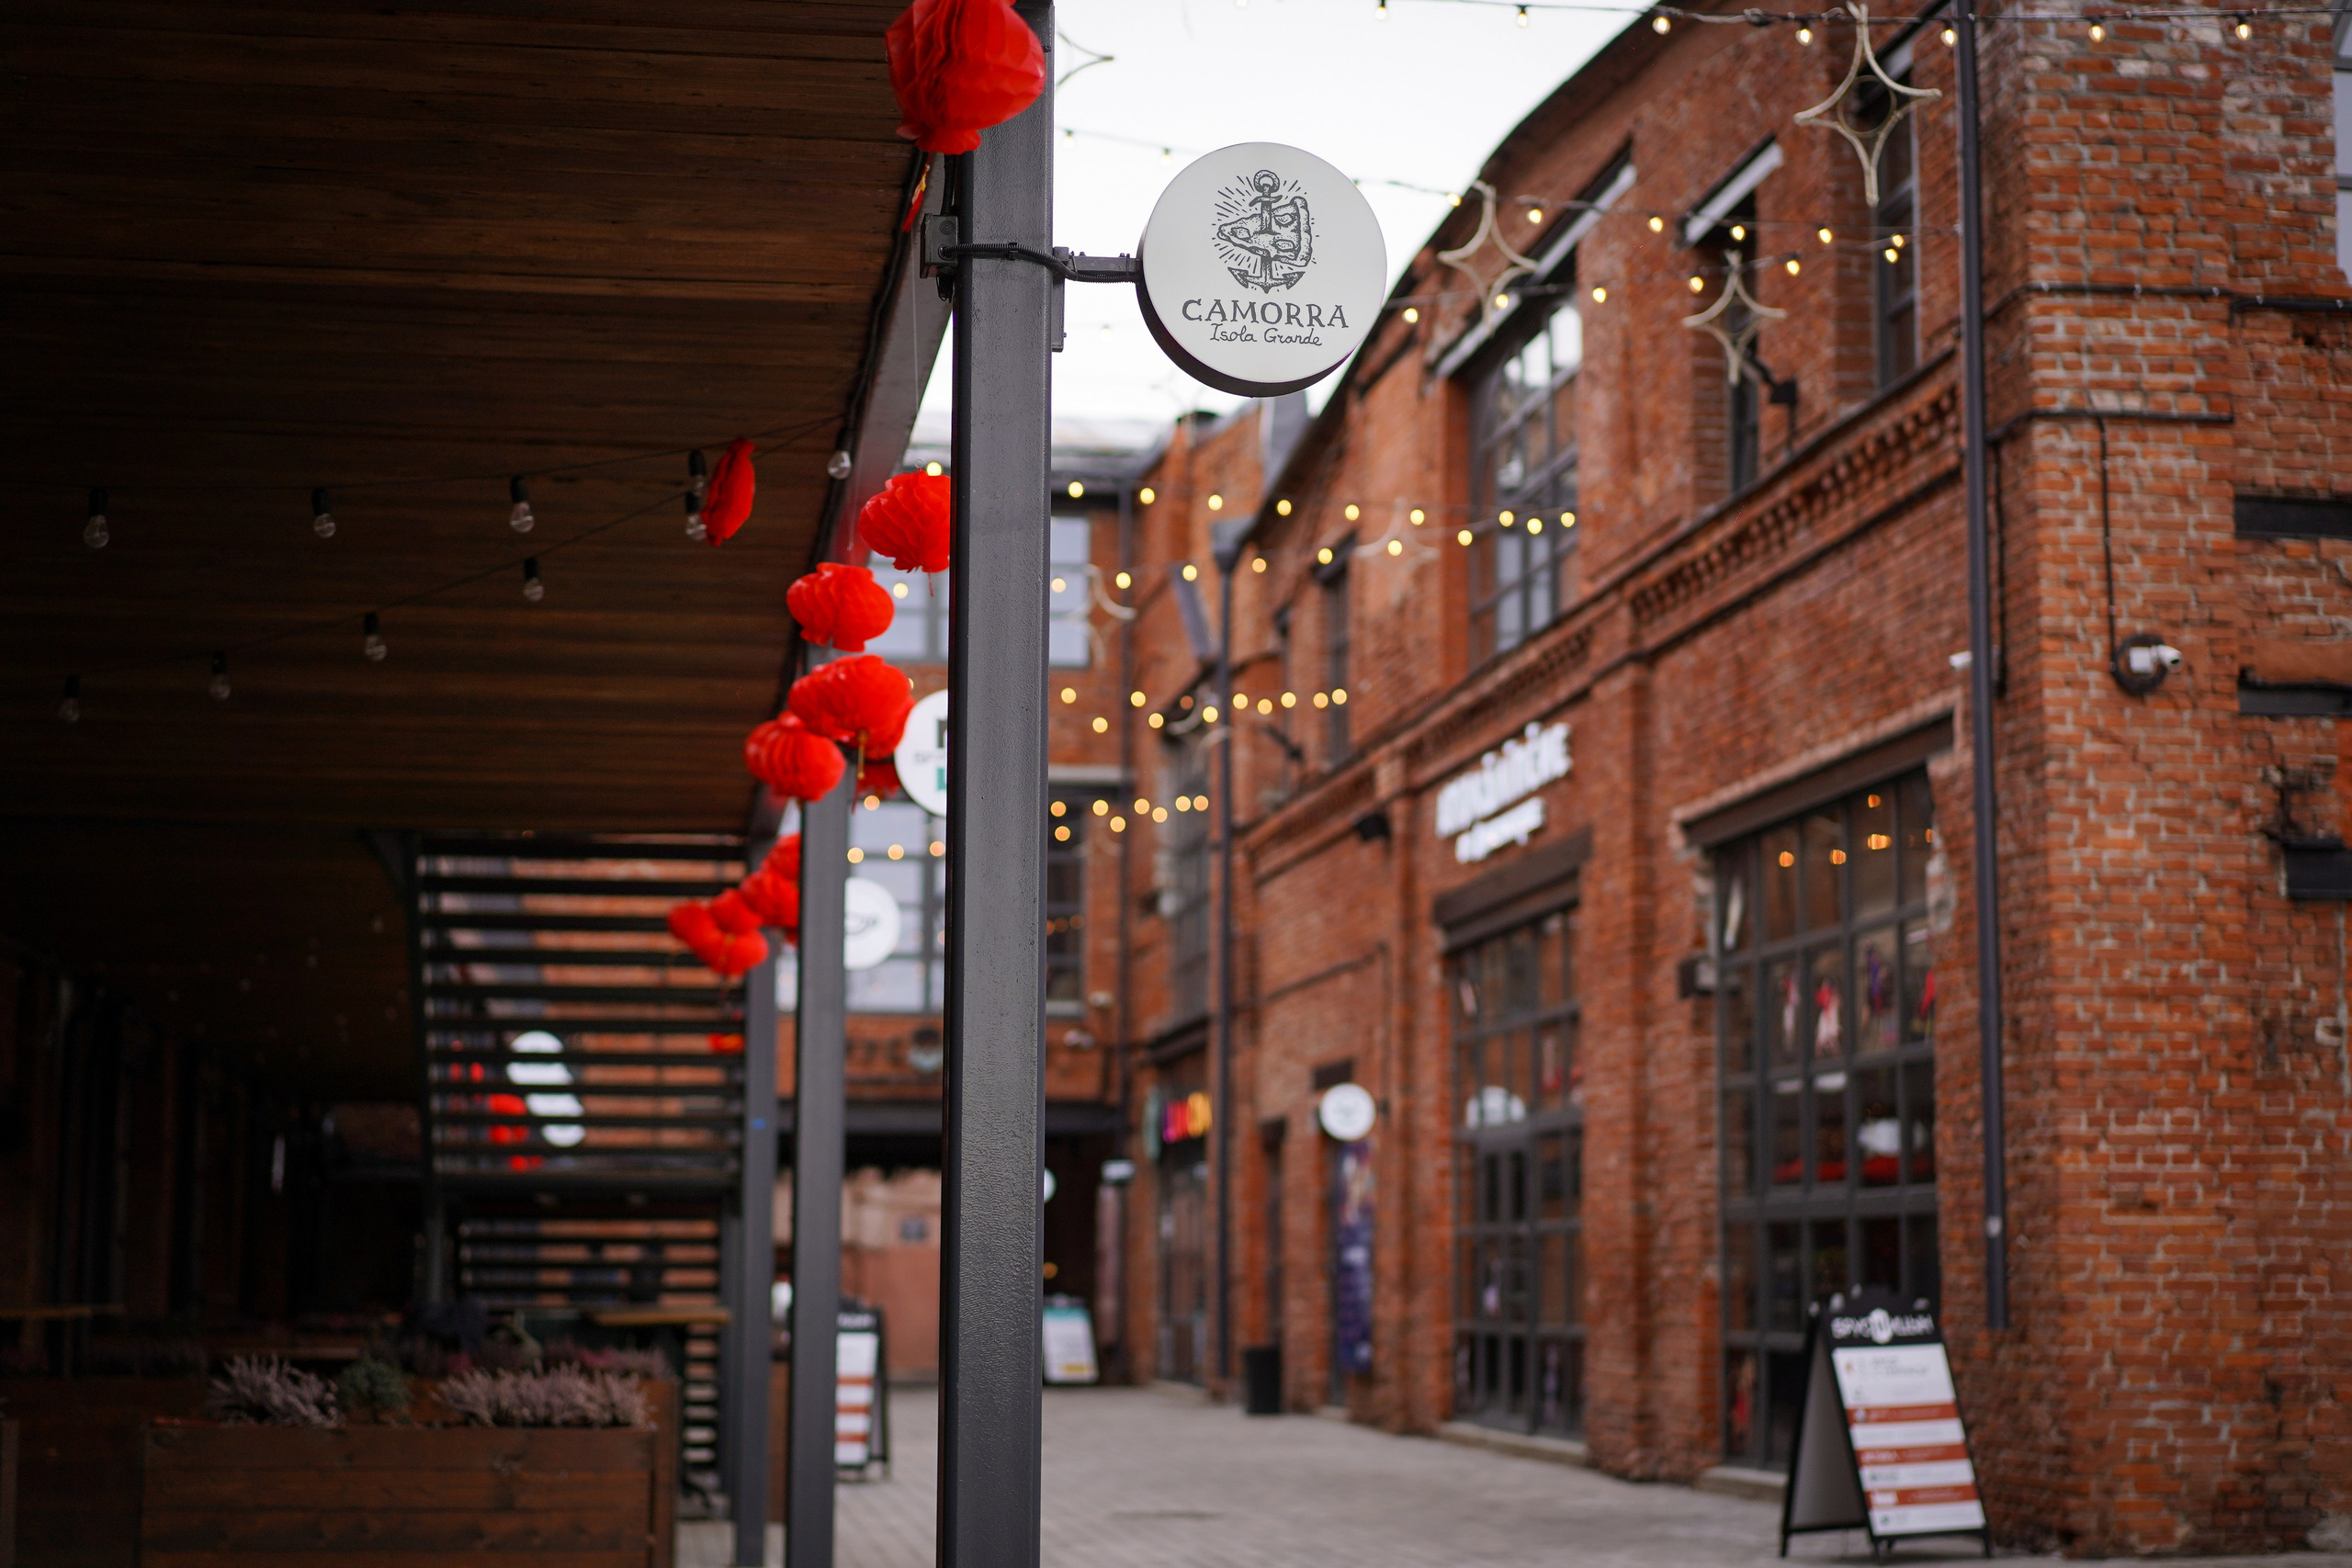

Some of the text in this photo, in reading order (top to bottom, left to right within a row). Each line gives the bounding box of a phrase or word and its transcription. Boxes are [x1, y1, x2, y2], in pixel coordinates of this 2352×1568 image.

[1182, 299, 1349, 329] CAMORRA
[1210, 323, 1323, 346] Isola Grande
